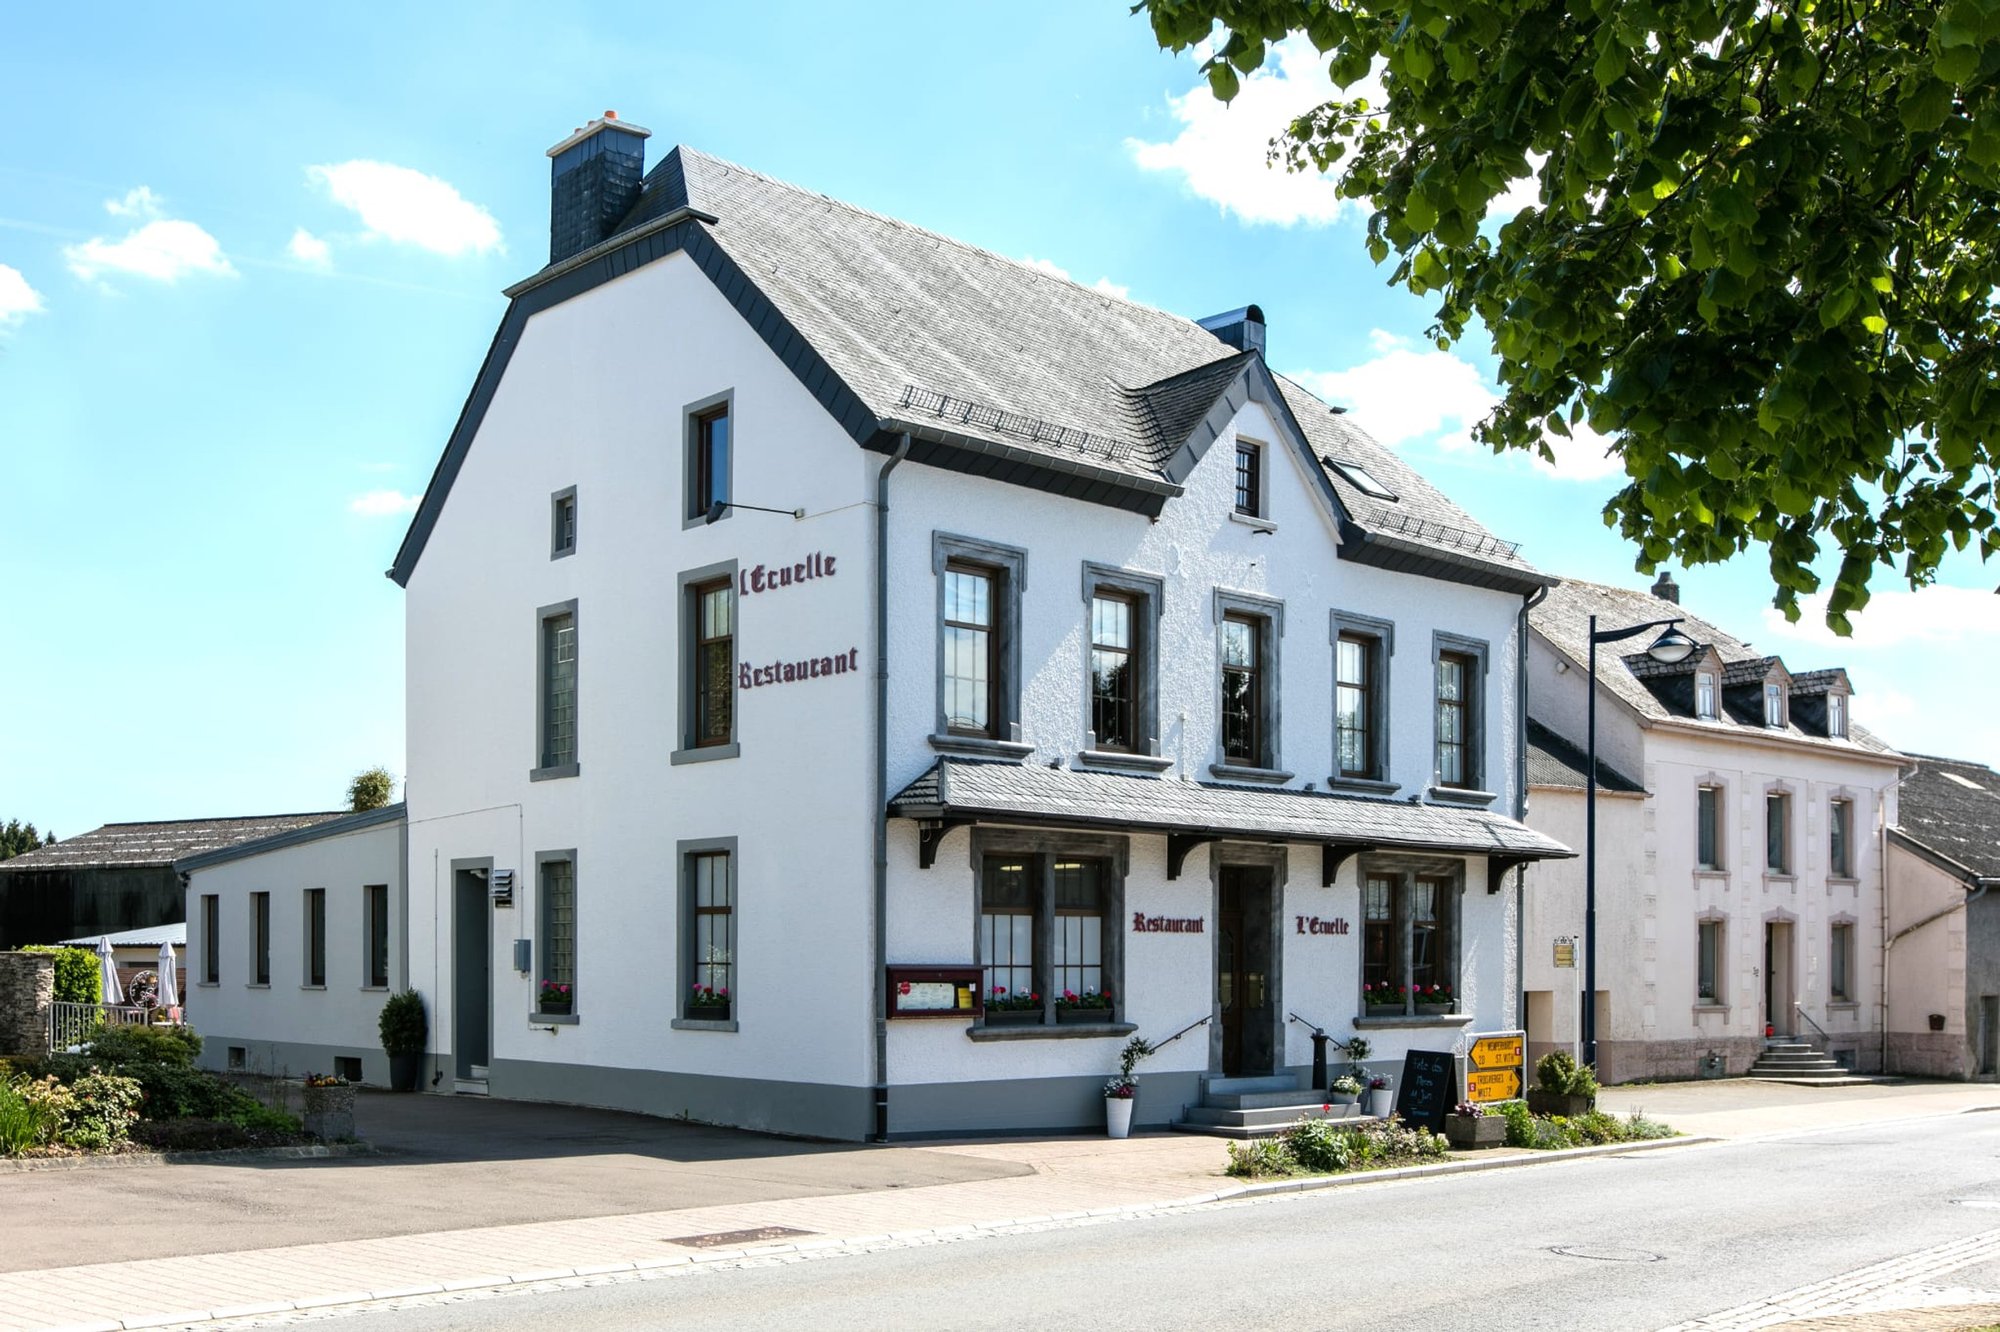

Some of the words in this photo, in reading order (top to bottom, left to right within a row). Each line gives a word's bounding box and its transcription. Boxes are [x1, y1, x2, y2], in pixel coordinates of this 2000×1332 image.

[738, 646, 858, 690] Restaurant
[1133, 912, 1204, 933] Restaurant
[1296, 916, 1350, 935] L'Ecuelle
